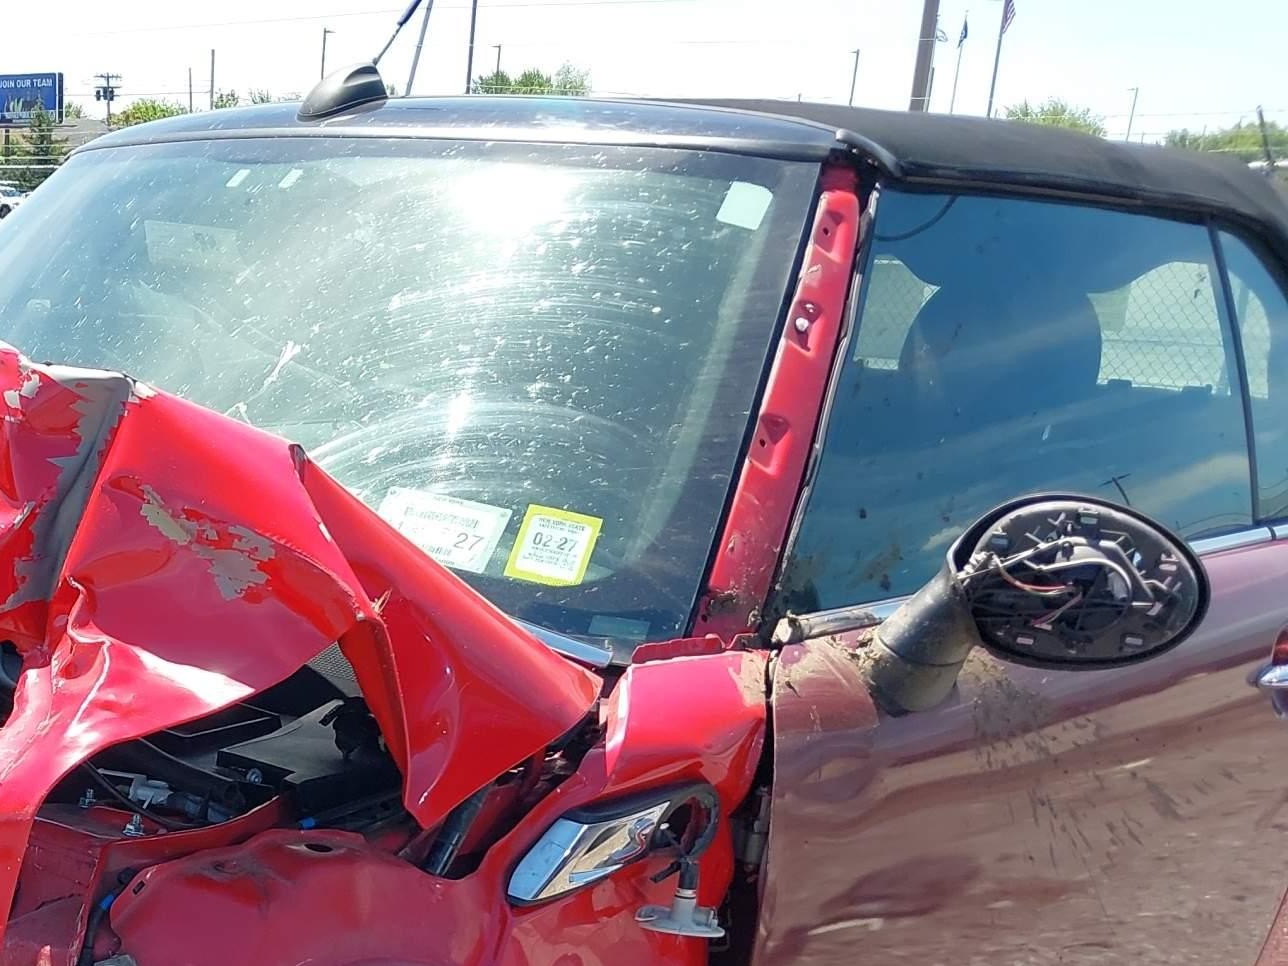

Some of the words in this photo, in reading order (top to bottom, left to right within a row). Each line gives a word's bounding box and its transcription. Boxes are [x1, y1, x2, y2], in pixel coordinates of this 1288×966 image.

[16, 79, 31, 88] OUR
[32, 78, 53, 88] TEAM
[453, 532, 485, 552] 27
[532, 531, 579, 553] 02-27
